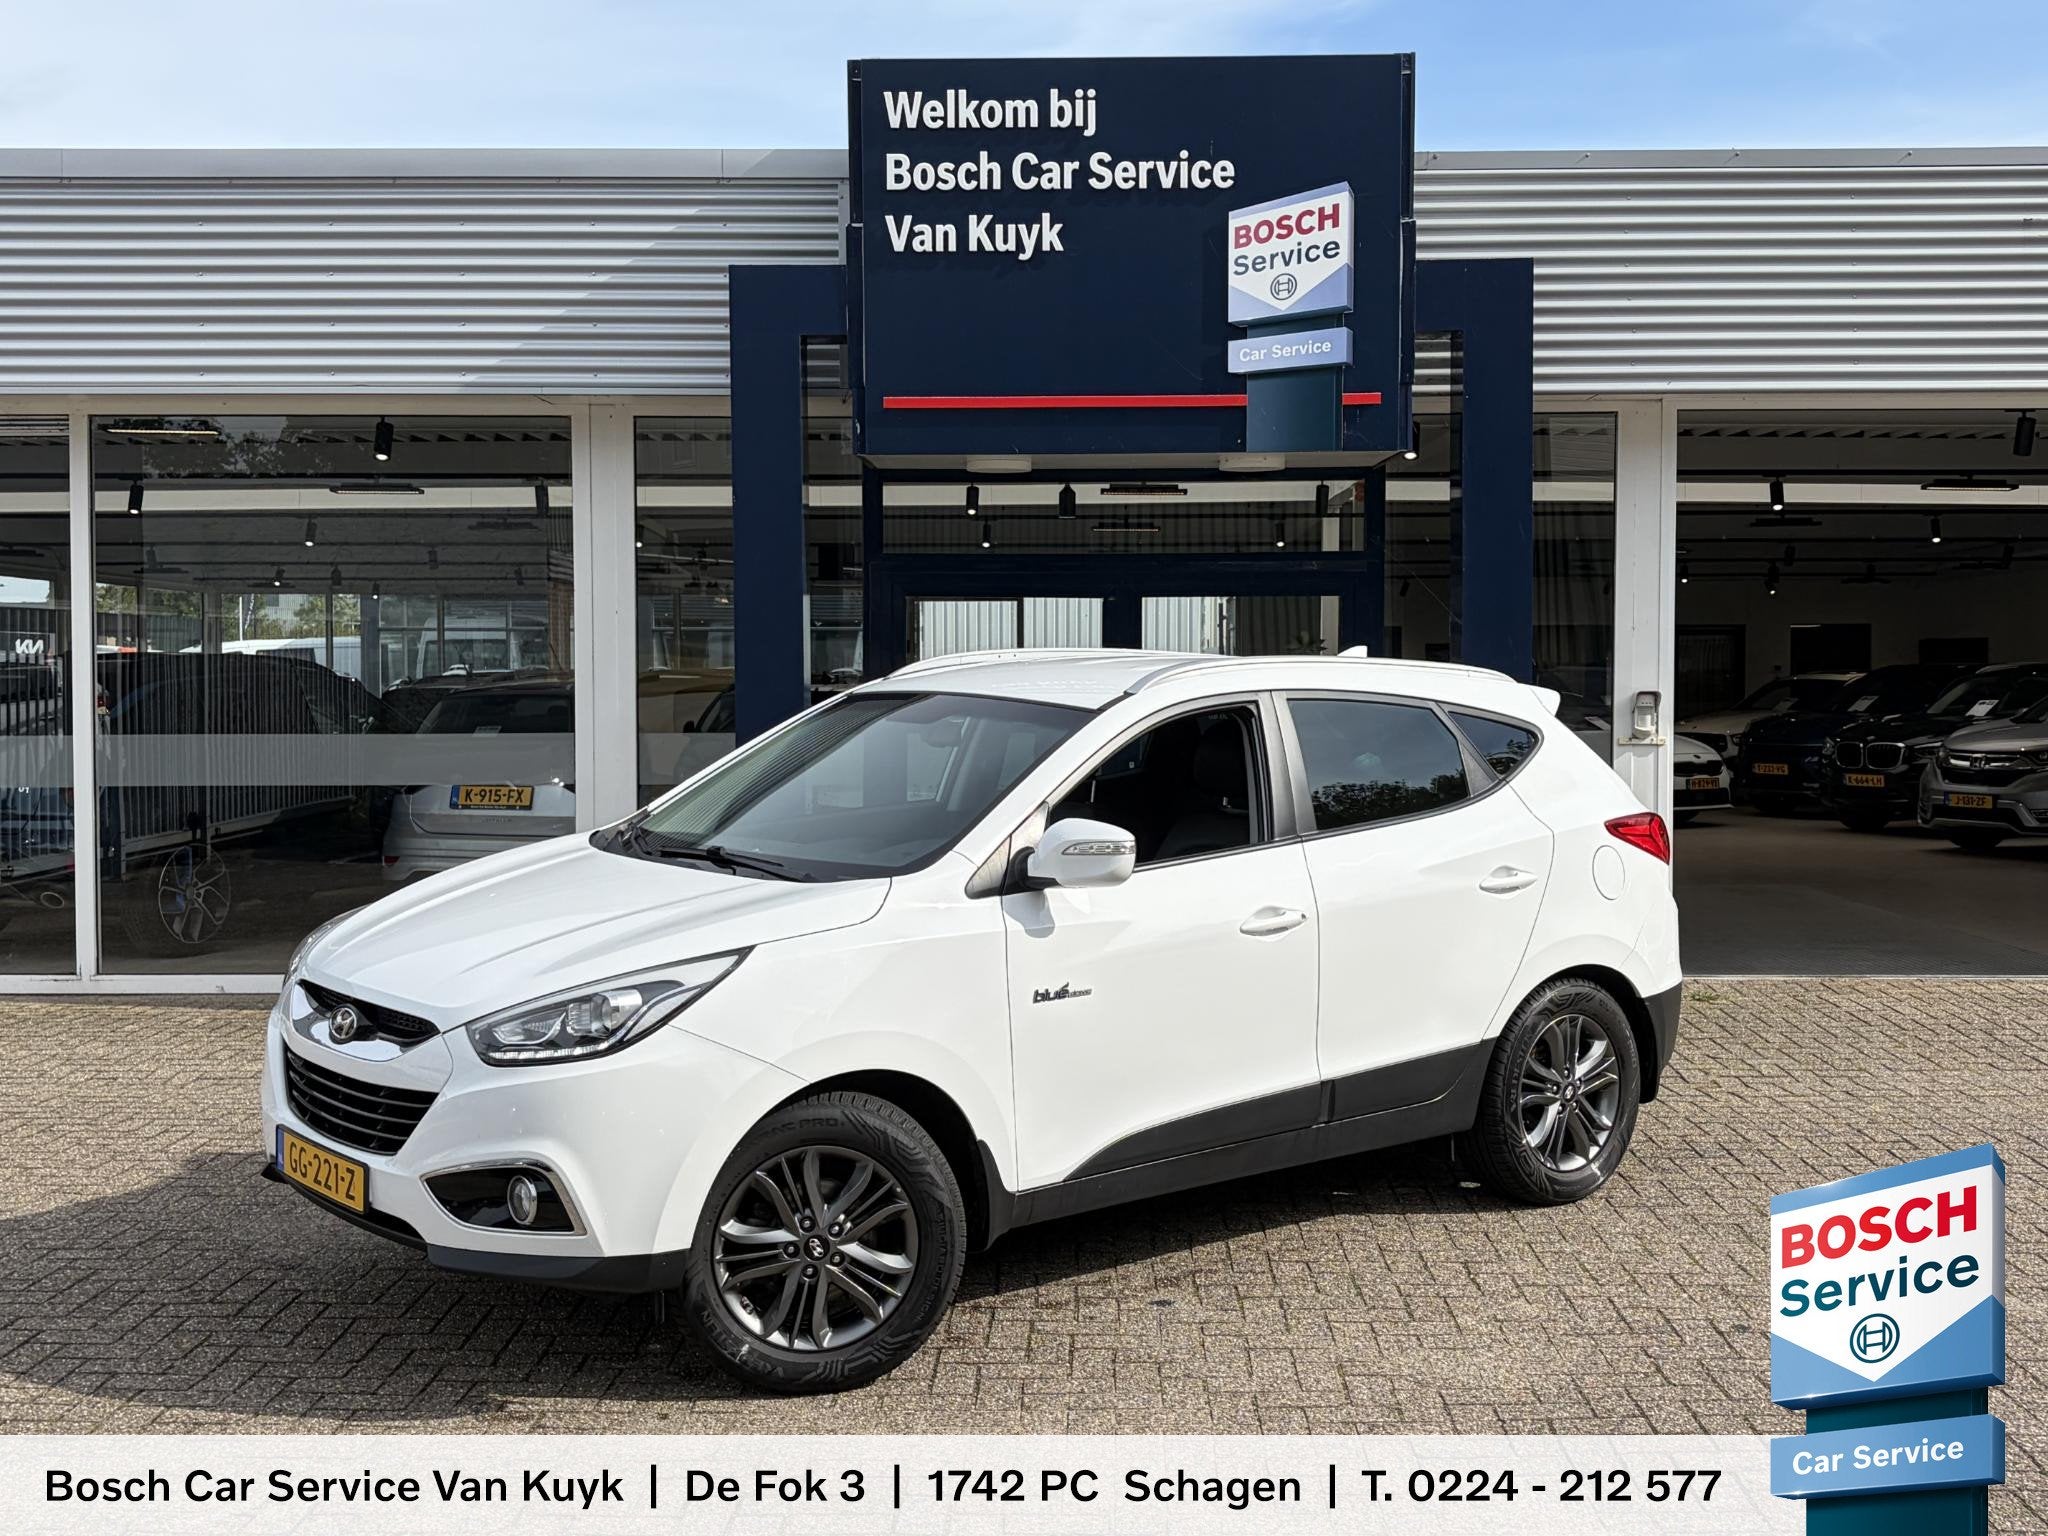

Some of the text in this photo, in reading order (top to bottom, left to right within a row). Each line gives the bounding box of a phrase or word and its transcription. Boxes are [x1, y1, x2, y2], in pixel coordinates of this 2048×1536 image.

[883, 89, 1097, 137] Welkom bij
[886, 150, 1235, 191] Bosch Car Service
[885, 212, 1064, 261] Van Kuyk
[1233, 203, 1340, 249] BOSCH
[1233, 240, 1341, 277] Service
[1239, 338, 1332, 362] Car Service
[464, 788, 524, 803] K-915-FX
[289, 1141, 356, 1202] GG-221-Z
